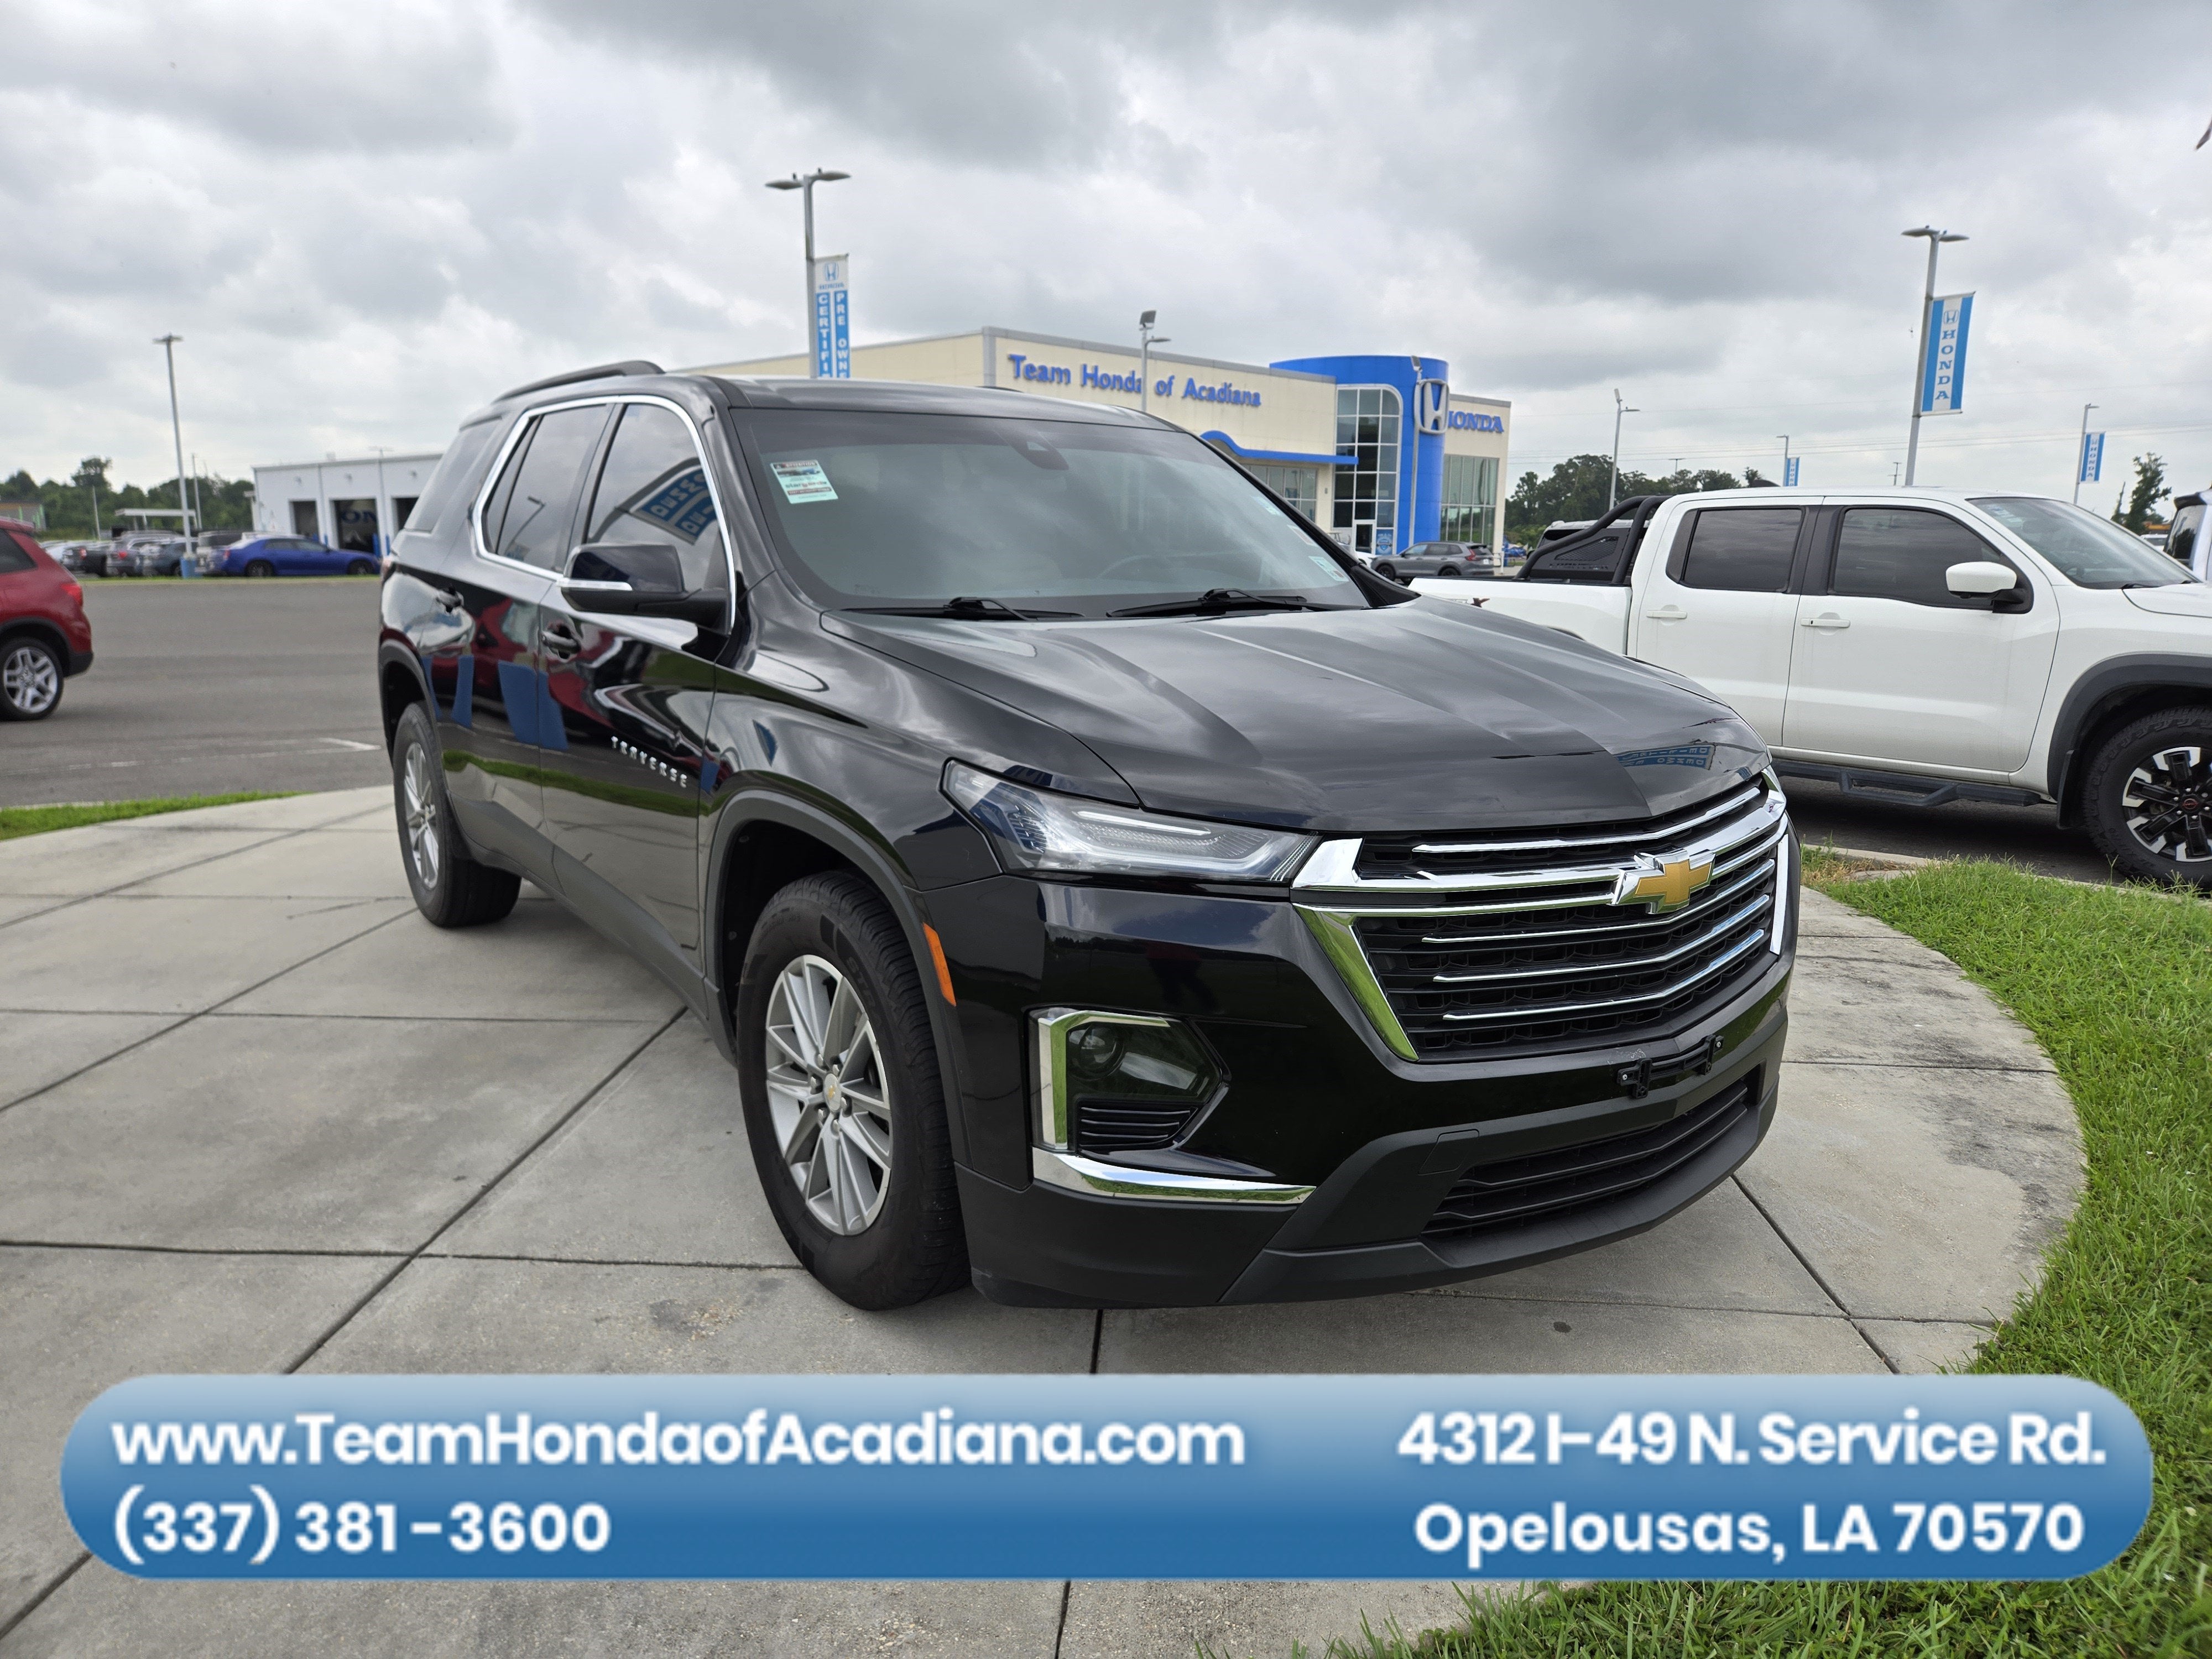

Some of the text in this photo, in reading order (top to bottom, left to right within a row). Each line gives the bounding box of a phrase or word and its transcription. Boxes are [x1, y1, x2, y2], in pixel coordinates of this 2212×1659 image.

[836, 293, 846, 325] PRE
[1008, 353, 1071, 385] Team
[1155, 375, 1175, 398] of
[1182, 377, 1261, 407] Acadiana
[1934, 329, 1957, 400] HONDA
[2086, 446, 2098, 477] HONDA
[611, 735, 687, 789] TRAVERSE
